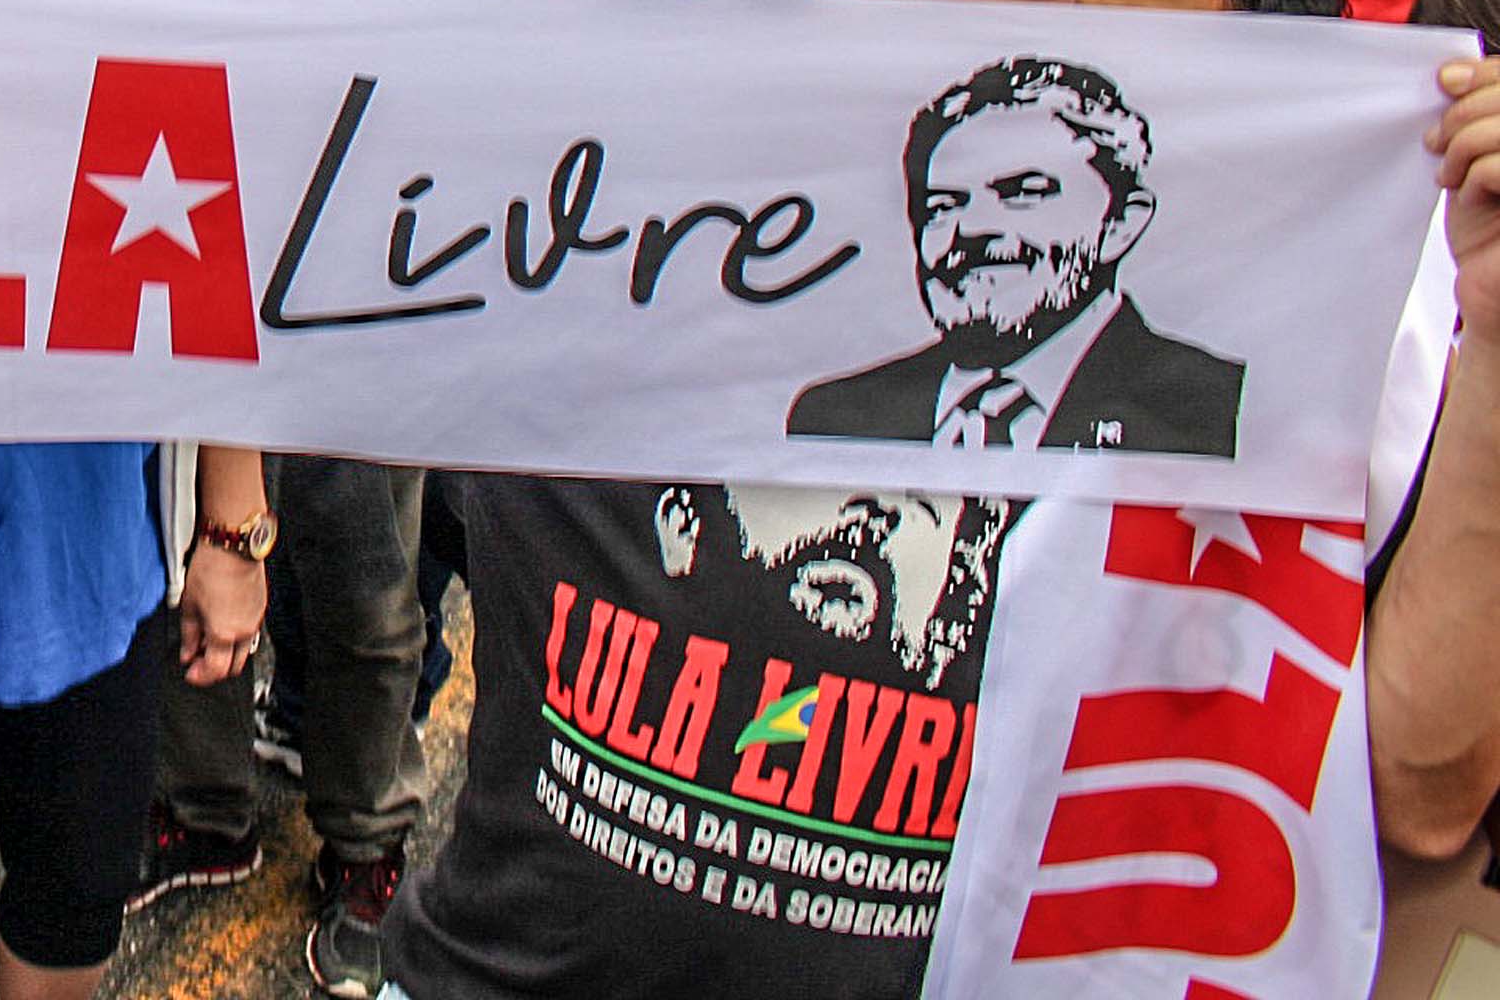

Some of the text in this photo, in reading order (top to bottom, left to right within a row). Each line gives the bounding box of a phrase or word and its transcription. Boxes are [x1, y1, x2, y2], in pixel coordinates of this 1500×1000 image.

[257, 76, 861, 330] Livre
[545, 582, 729, 779] LULA
[1012, 503, 1365, 1000] ULA
[535, 767, 940, 937] DOS DIREITOS E DA SOBERAN
[551, 737, 581, 787] EM
[582, 762, 687, 841] DEFESA
[694, 810, 738, 858] DA
